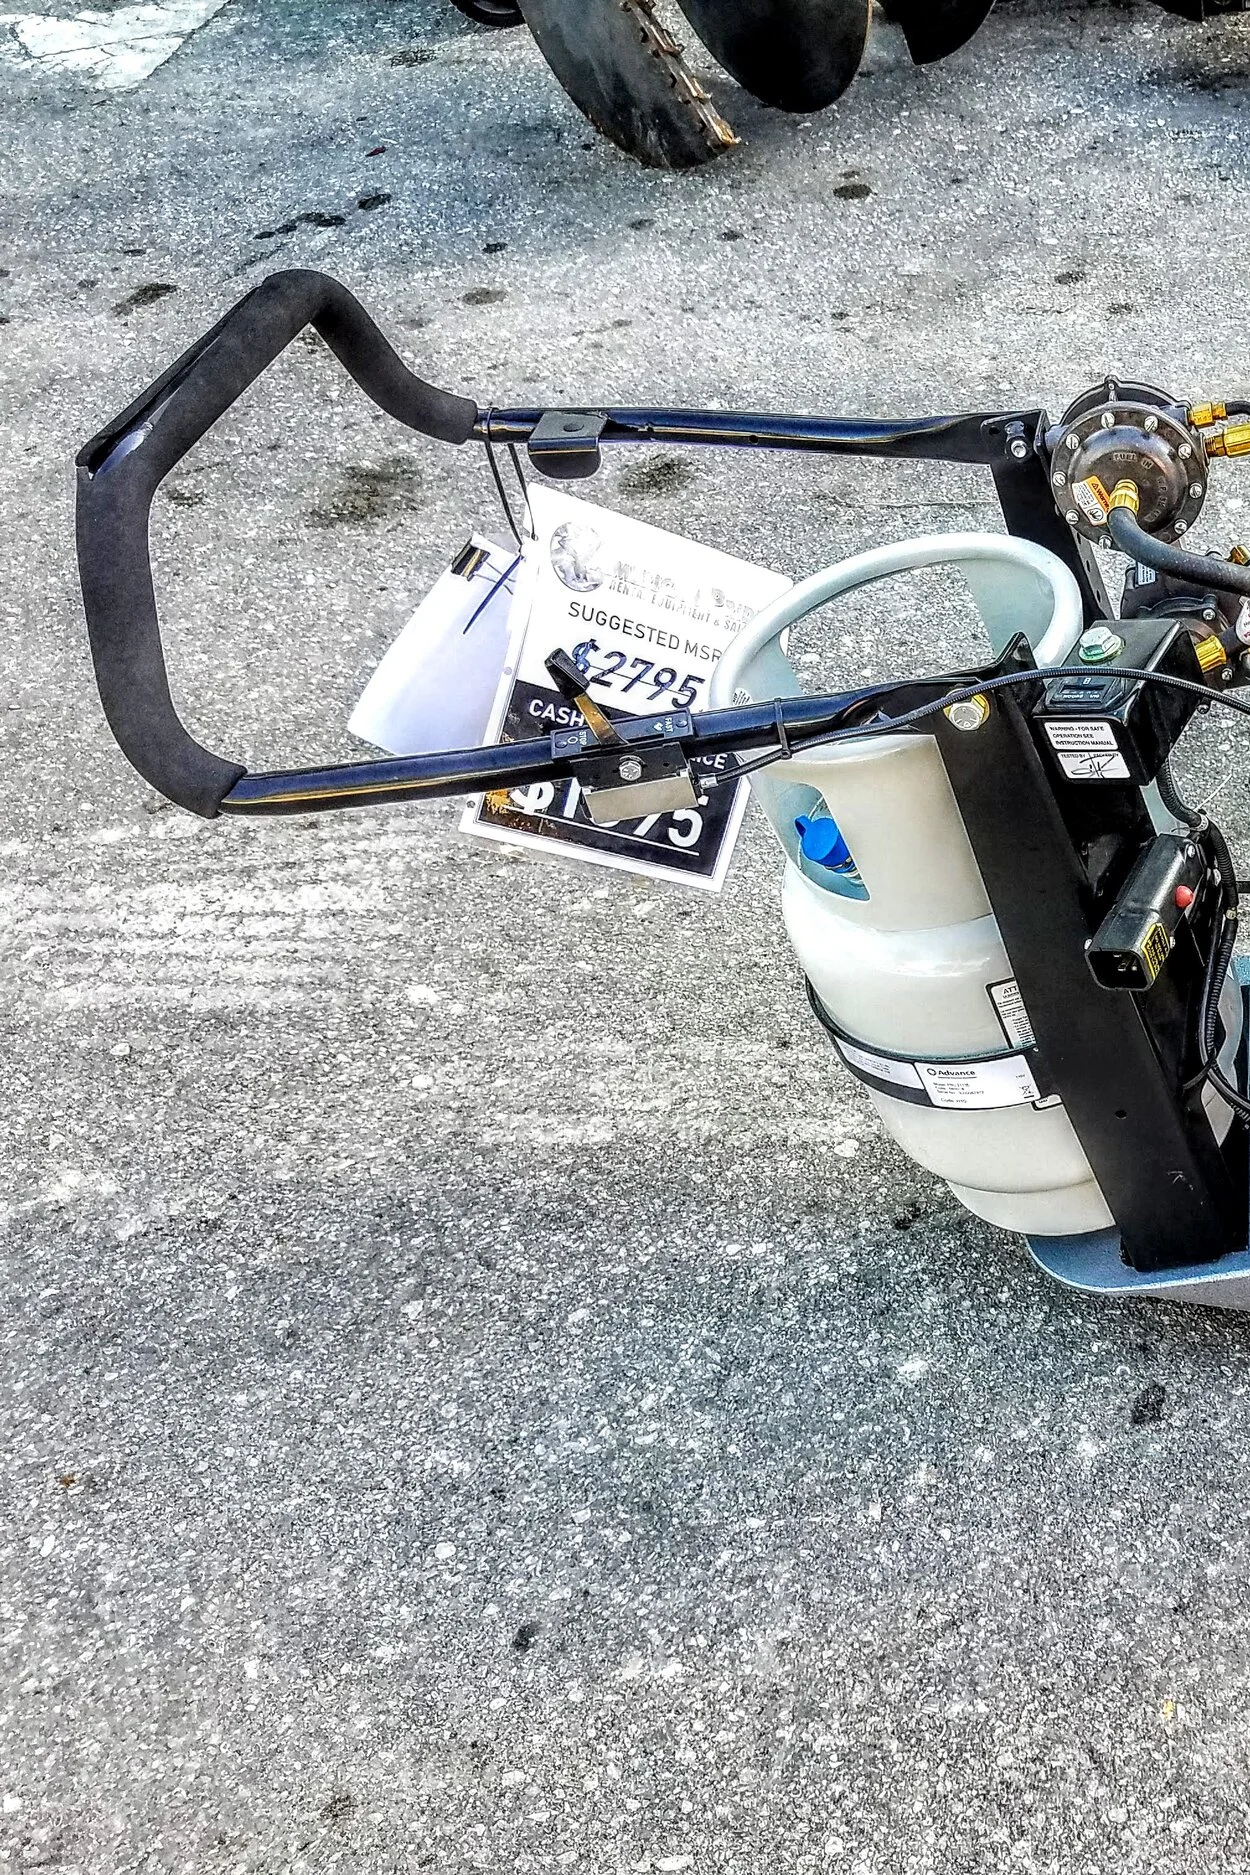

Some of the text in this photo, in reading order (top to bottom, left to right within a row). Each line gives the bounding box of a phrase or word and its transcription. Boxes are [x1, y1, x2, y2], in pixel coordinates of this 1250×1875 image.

[1113, 452, 1154, 470] FUEL IN
[568, 601, 681, 650] SUGGESTED
[571, 638, 706, 709] $2795
[528, 699, 585, 728] CASH
[664, 716, 674, 733] FAST
[578, 730, 588, 746] STOP
